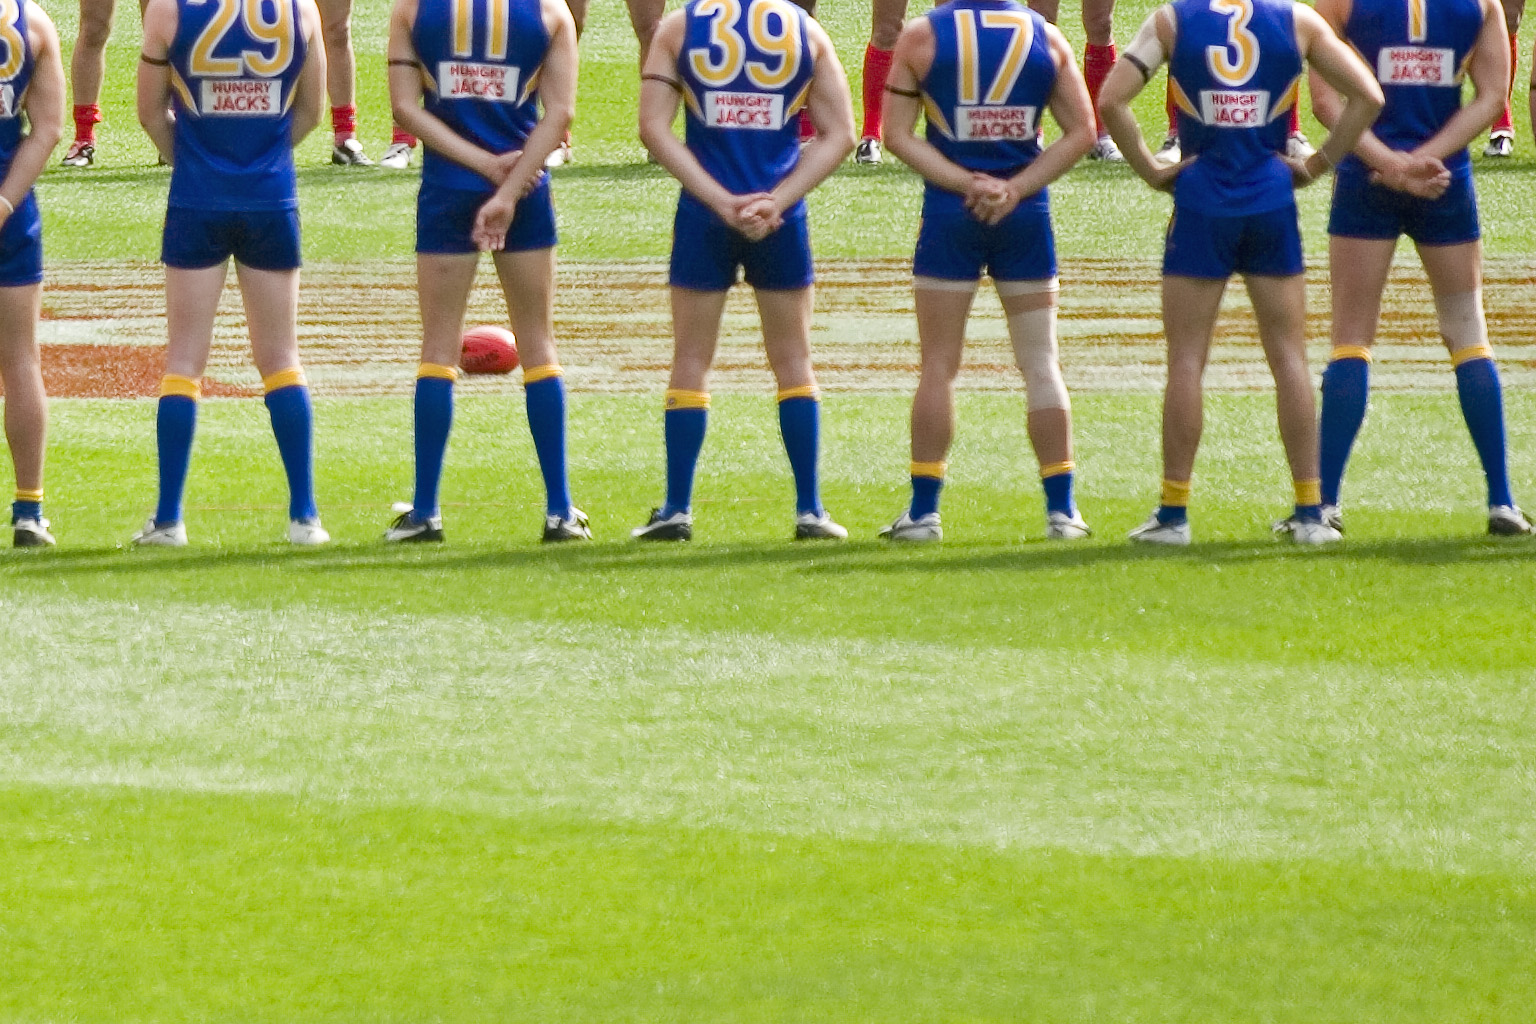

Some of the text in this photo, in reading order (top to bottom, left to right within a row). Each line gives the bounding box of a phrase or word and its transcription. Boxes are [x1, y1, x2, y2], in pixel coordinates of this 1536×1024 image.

[954, 8, 1034, 106] 17
[450, 65, 506, 77] HUNGRY
[212, 82, 271, 93] HUNGRY
[1212, 94, 1258, 105] HUNGR
